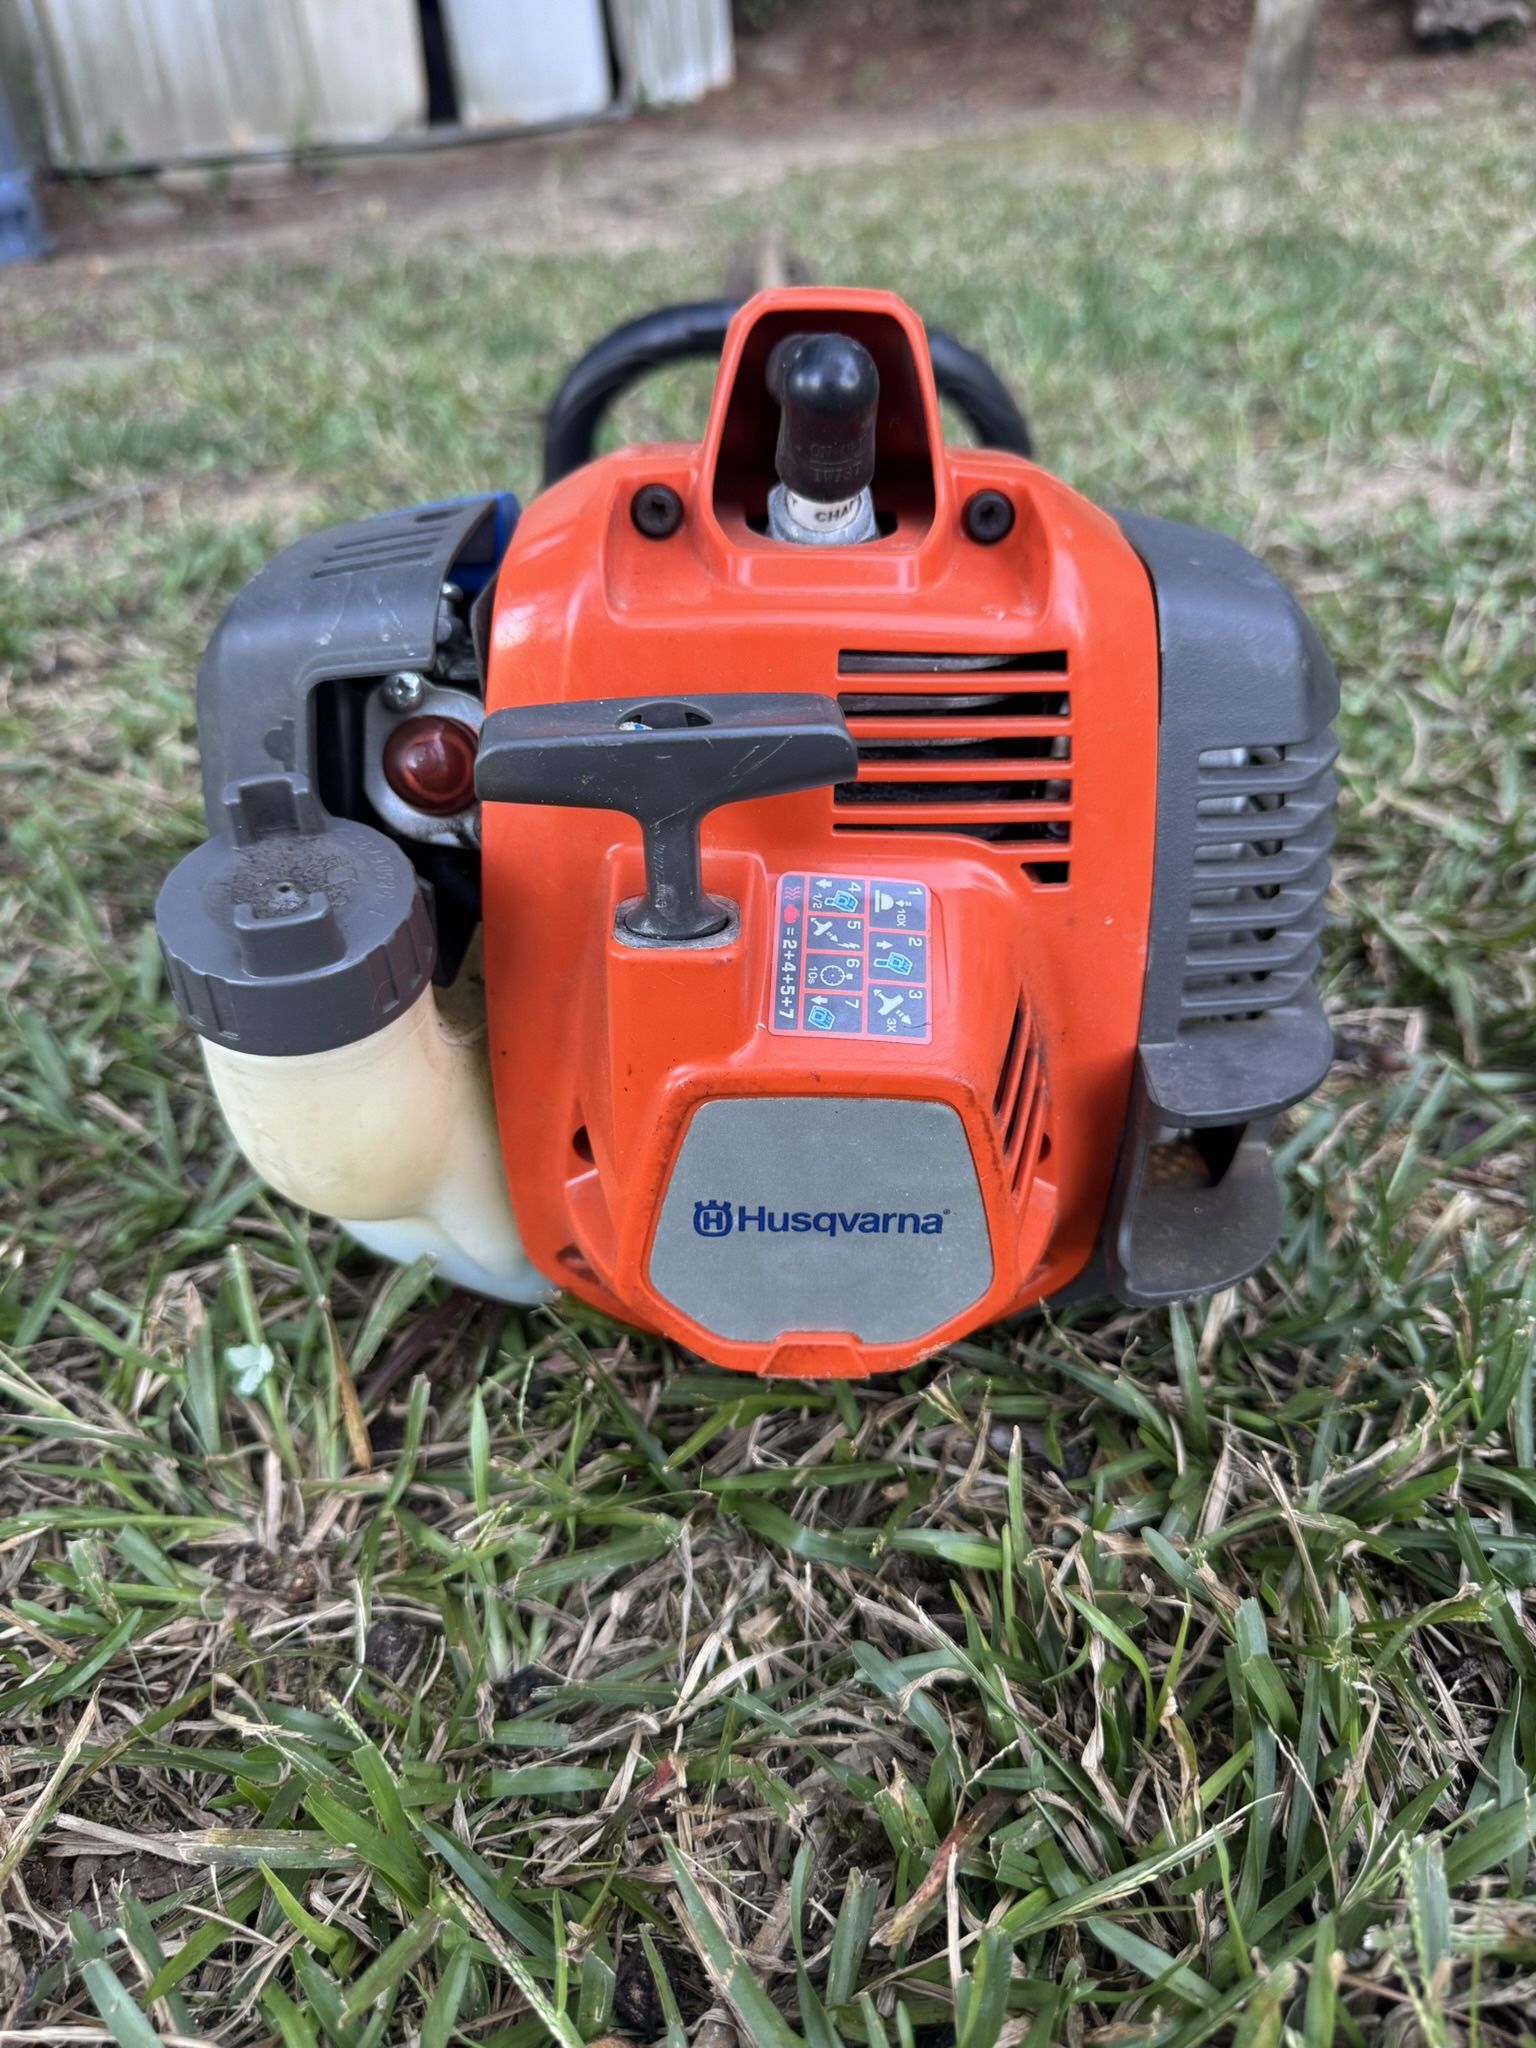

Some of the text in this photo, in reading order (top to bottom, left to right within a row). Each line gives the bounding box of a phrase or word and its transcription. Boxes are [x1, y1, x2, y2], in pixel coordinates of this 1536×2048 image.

[848, 881, 862, 893] 4
[908, 887, 923, 895] 1
[812, 893, 823, 909] 1/2
[896, 909, 907, 927] 10X
[847, 920, 861, 930] 5
[908, 937, 923, 947] 2
[846, 958, 860, 968] 6
[808, 966, 818, 984] 10s
[908, 989, 923, 999] 3
[845, 999, 860, 1009] 7
[886, 1017, 897, 1032] 3X
[738, 1205, 944, 1237] Husqvarna
